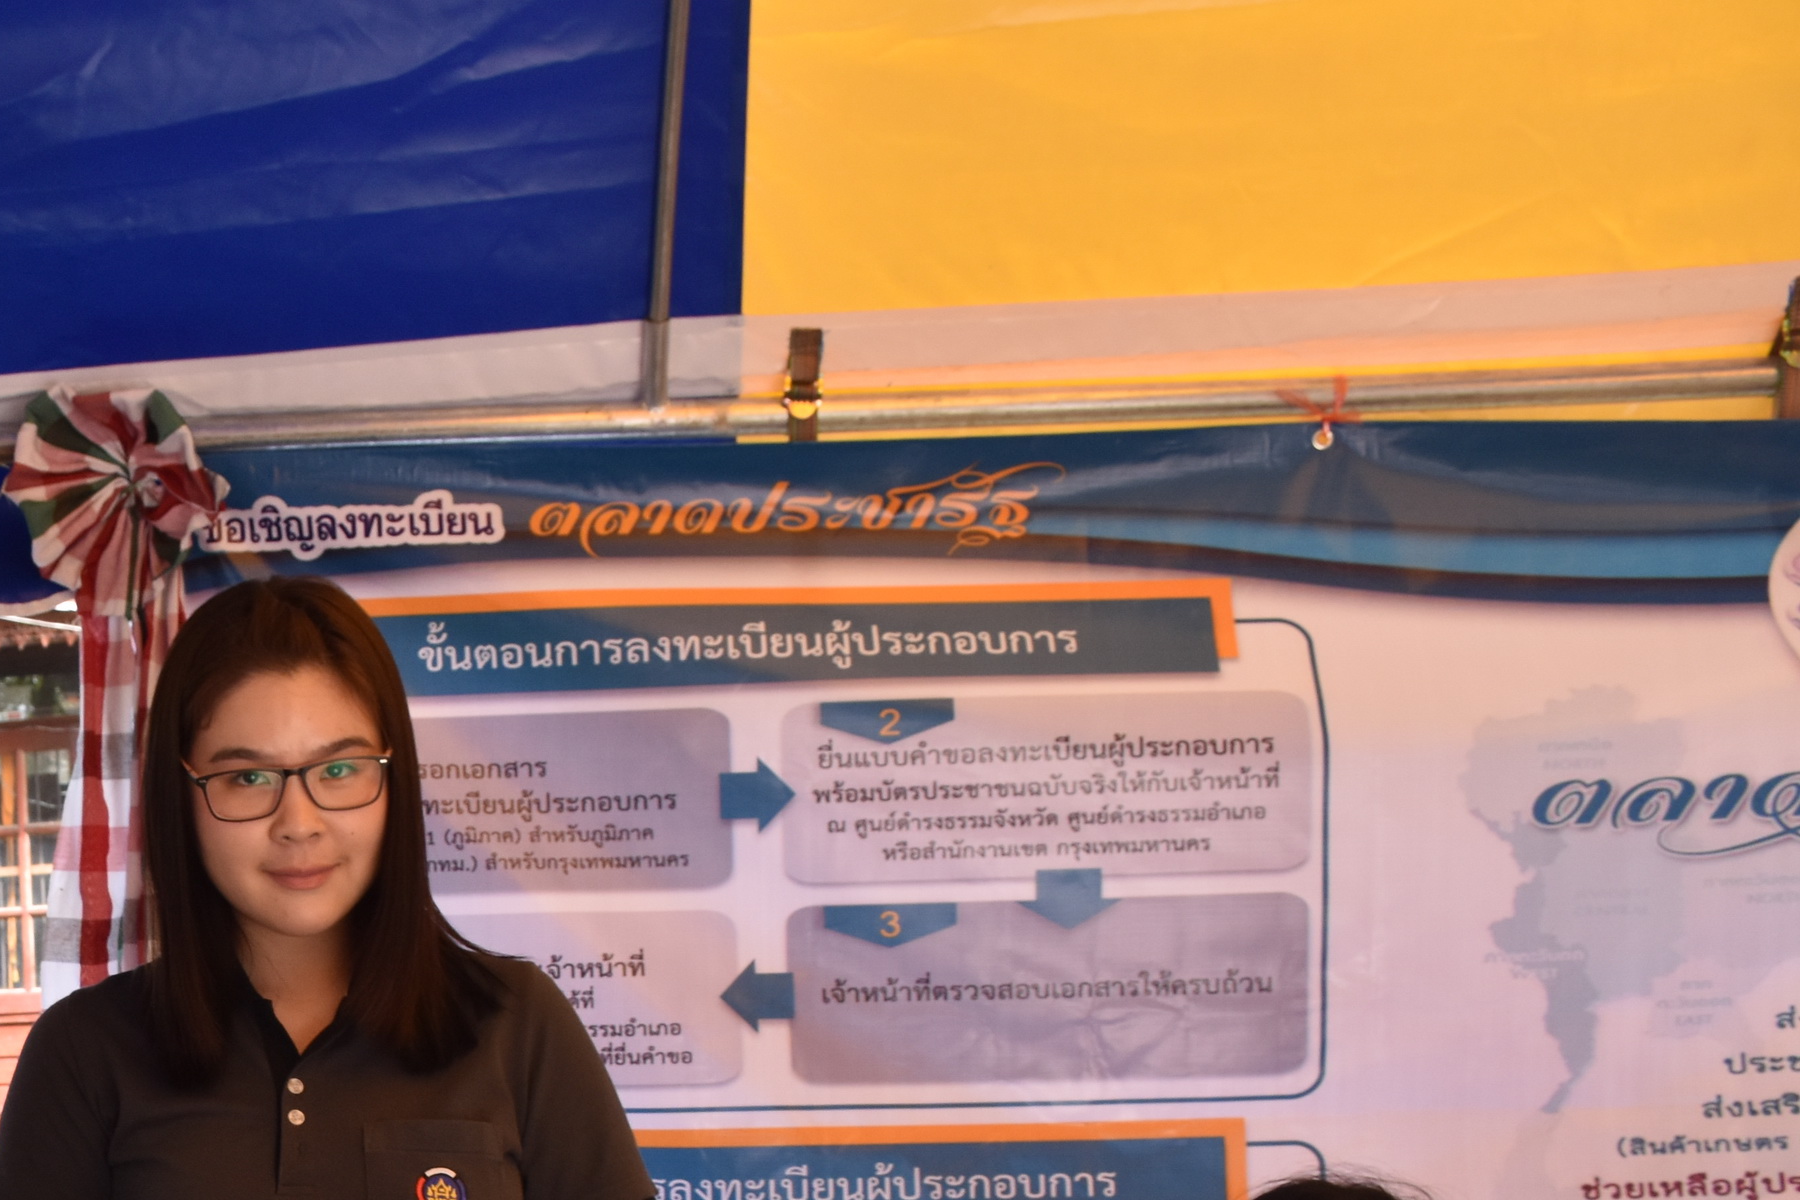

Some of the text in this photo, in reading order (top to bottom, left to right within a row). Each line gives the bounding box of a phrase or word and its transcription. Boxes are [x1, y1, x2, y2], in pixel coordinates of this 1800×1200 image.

[528, 461, 1066, 557] ตลาดประชารัฐ
[418, 621, 1079, 673] ขั้นตอนการลงทะเบียนผู้ประกอบการ
[879, 708, 901, 736] 2
[818, 733, 1275, 769] ยื่นแบบคำขอลงทะเบียนผู้ประกอบการ
[812, 762, 1281, 803] พร้อมบัตรประชาชนฉบับจริงให้กับเจ้าหน้าที่
[529, 824, 655, 849] สำหรับภูมิภาค
[485, 851, 690, 875] สำหรับกรุงเทพมหานคร
[880, 911, 901, 938] 3
[820, 968, 1273, 1004] เจ้าหน้าที่ตรวจสอบเอกสารให้ครบถ้วน
